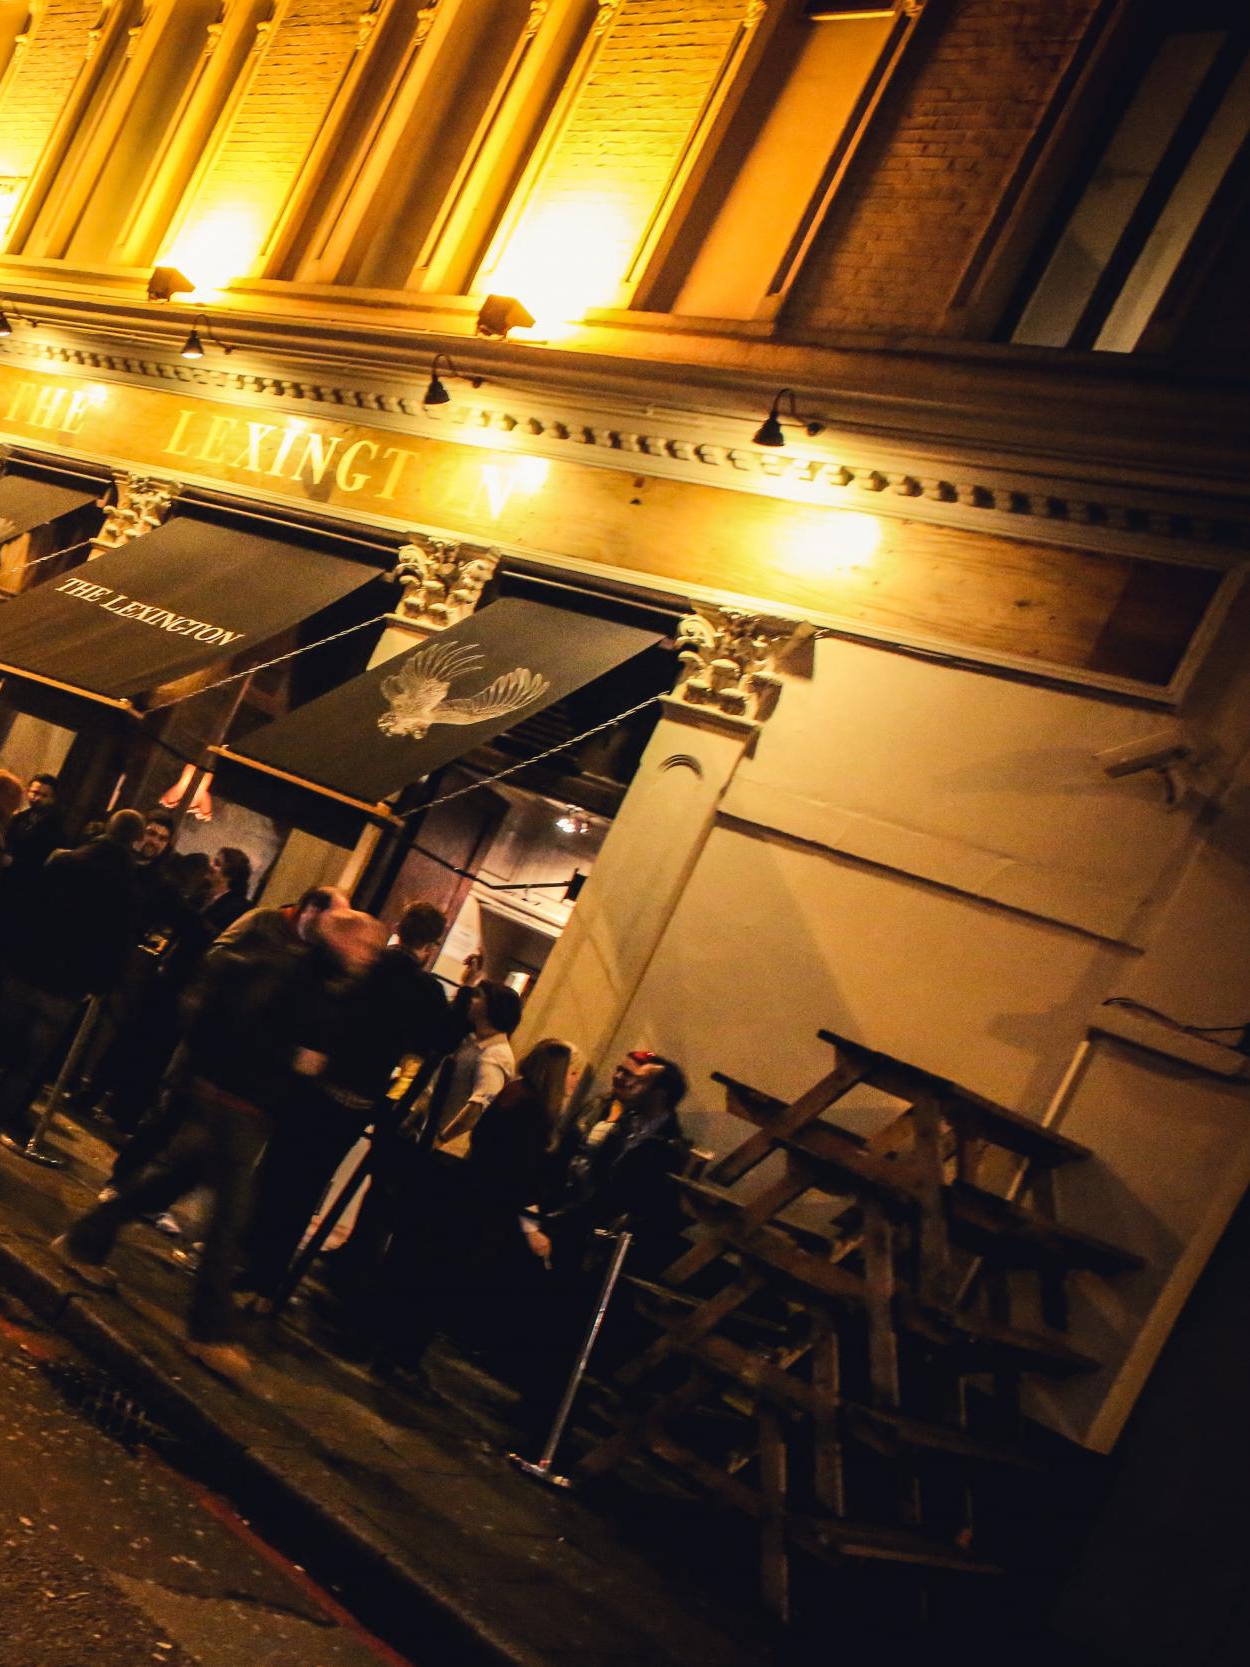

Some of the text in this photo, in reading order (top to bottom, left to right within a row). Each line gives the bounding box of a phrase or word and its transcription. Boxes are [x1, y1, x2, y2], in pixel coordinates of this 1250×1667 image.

[3, 380, 518, 521] THE LEXINGTN
[54, 577, 246, 646] THE LEXINGTON
